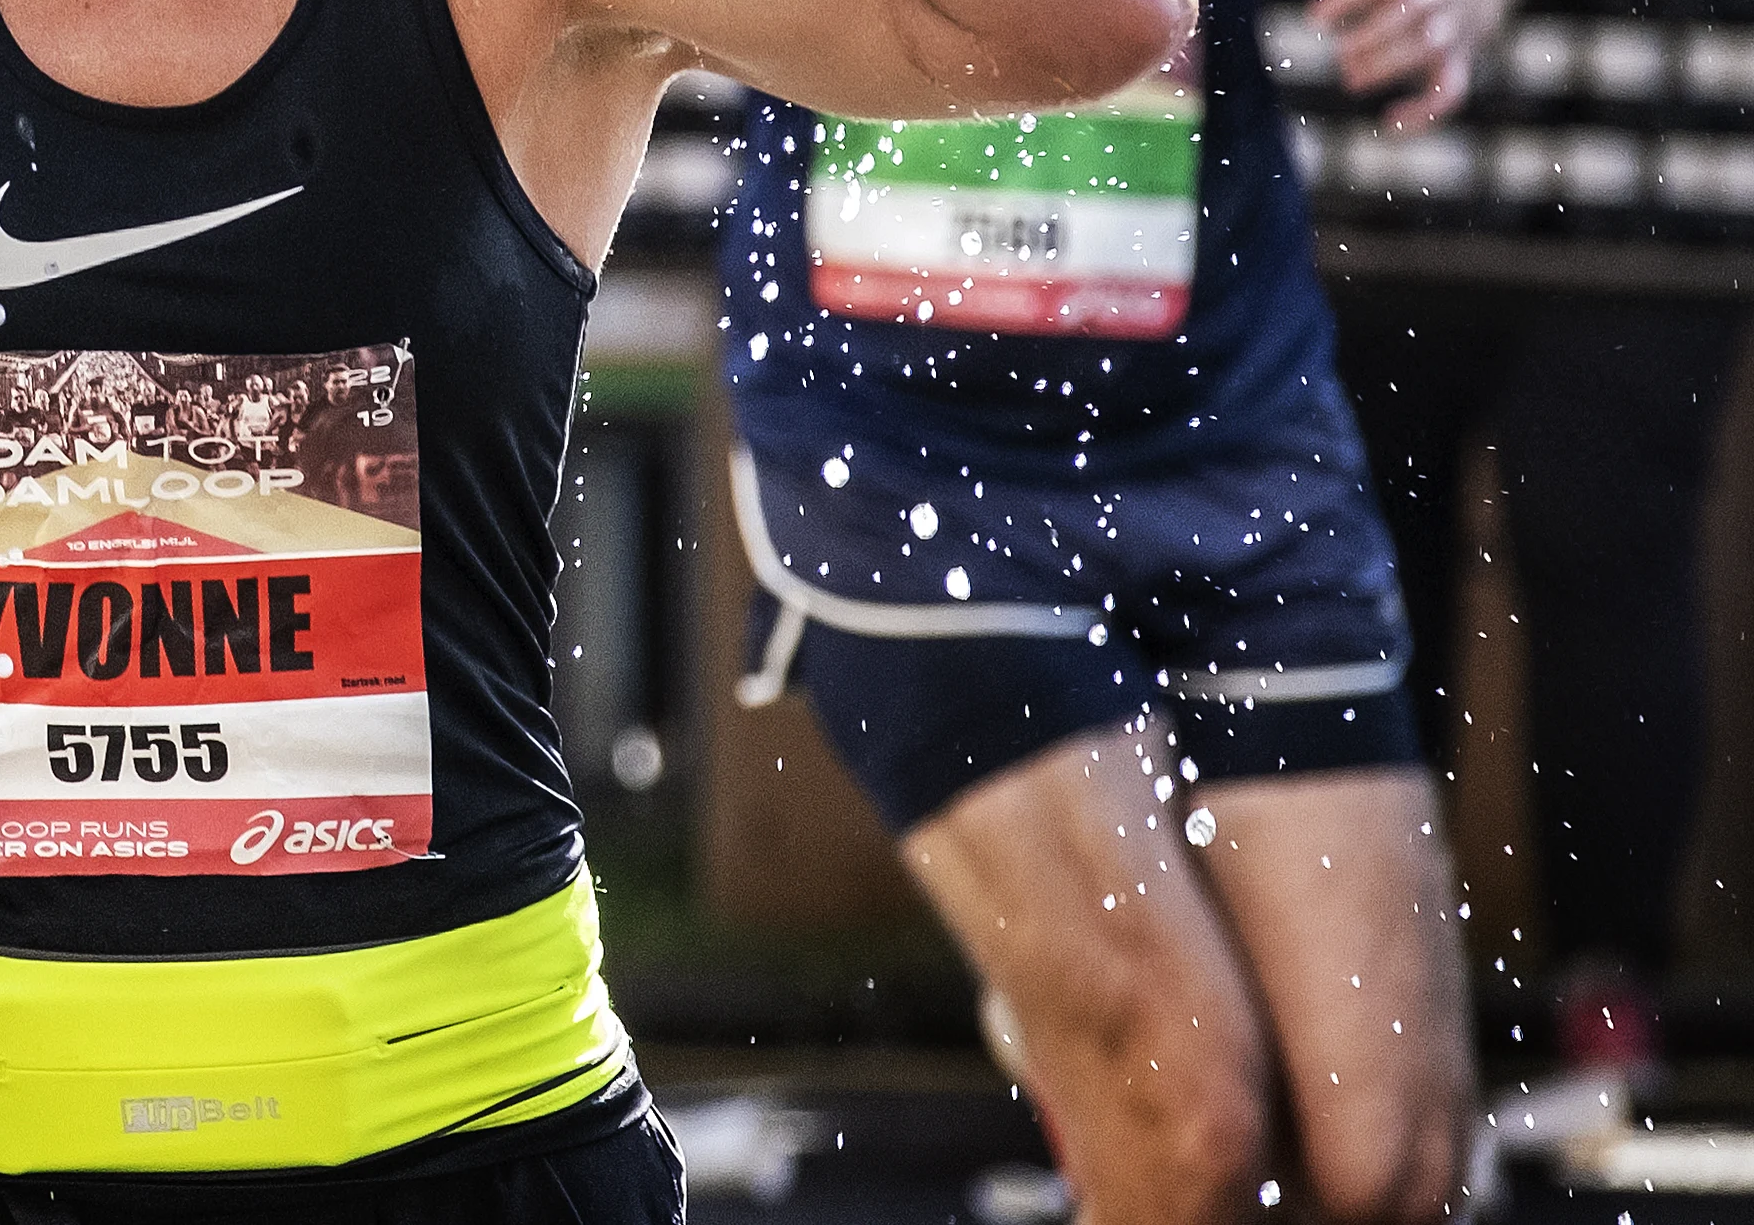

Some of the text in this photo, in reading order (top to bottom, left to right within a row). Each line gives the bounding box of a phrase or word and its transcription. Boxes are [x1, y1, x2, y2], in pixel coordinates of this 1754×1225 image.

[349, 365, 391, 387] 22
[357, 408, 394, 427] 19
[146, 434, 279, 465] TOT
[47, 723, 229, 783] 5755
[80, 821, 169, 839] RUNS
[33, 841, 83, 857] ON
[90, 841, 189, 858] ASICS
